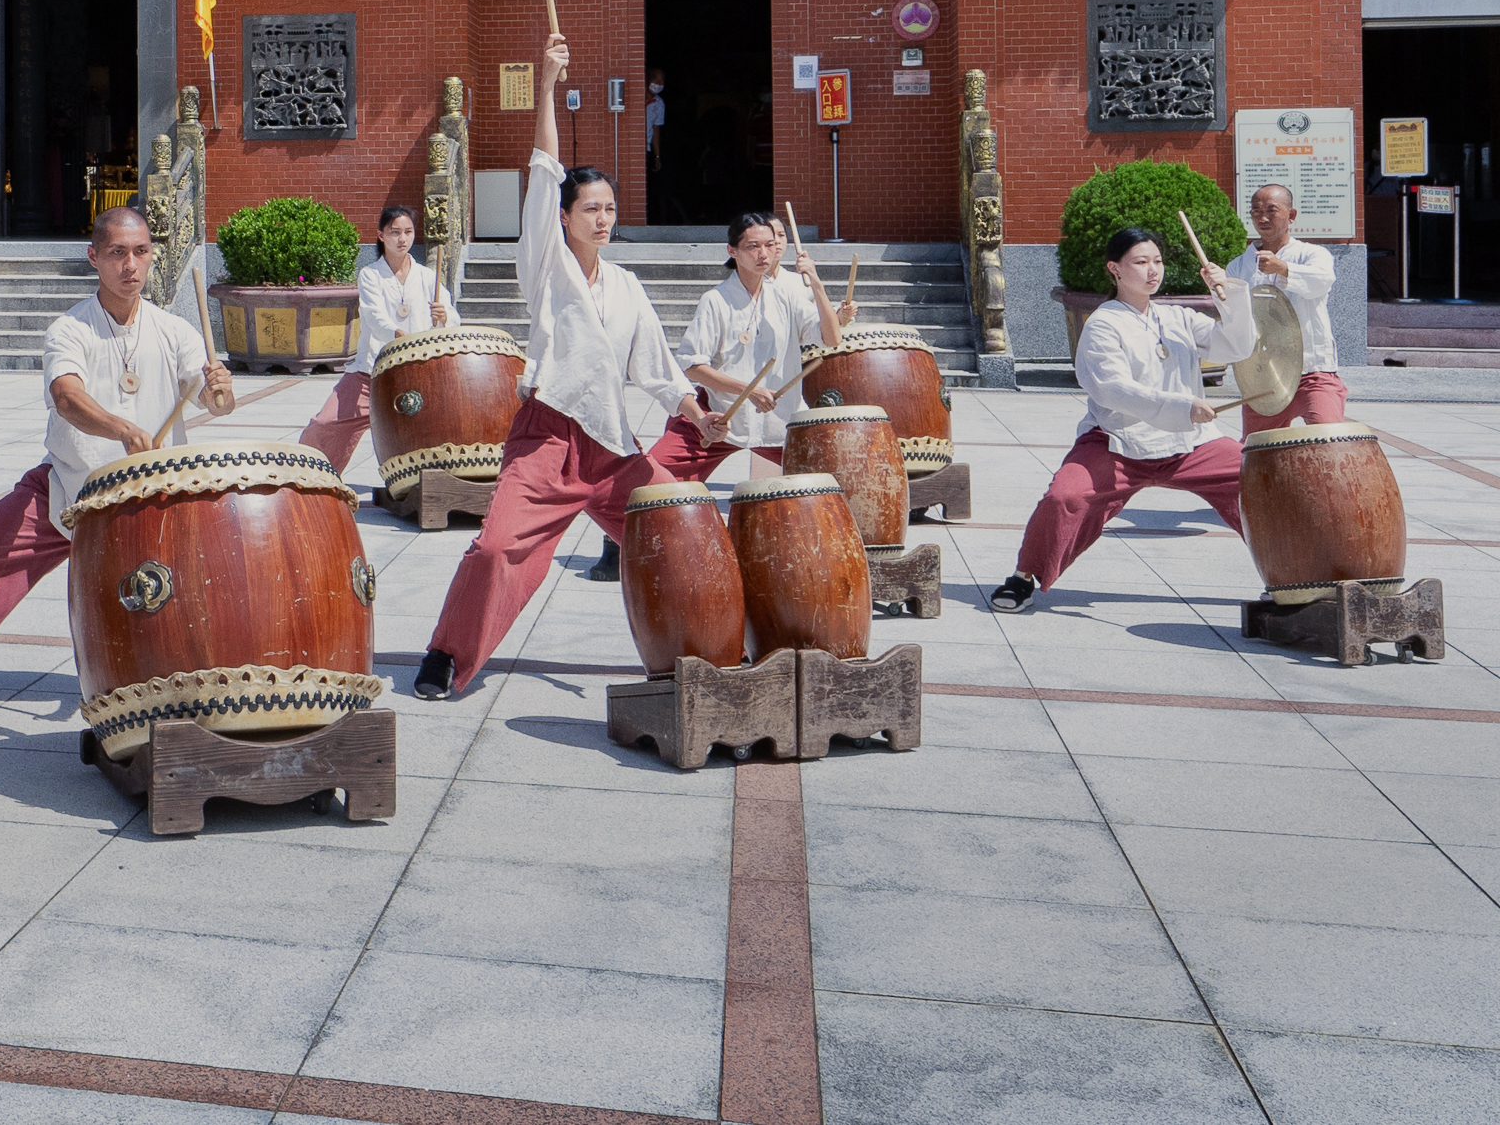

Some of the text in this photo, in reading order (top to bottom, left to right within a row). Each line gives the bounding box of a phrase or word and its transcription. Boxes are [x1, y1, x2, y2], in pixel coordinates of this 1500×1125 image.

[822, 80, 833, 119] 入口處
[832, 78, 845, 118] 參拜
